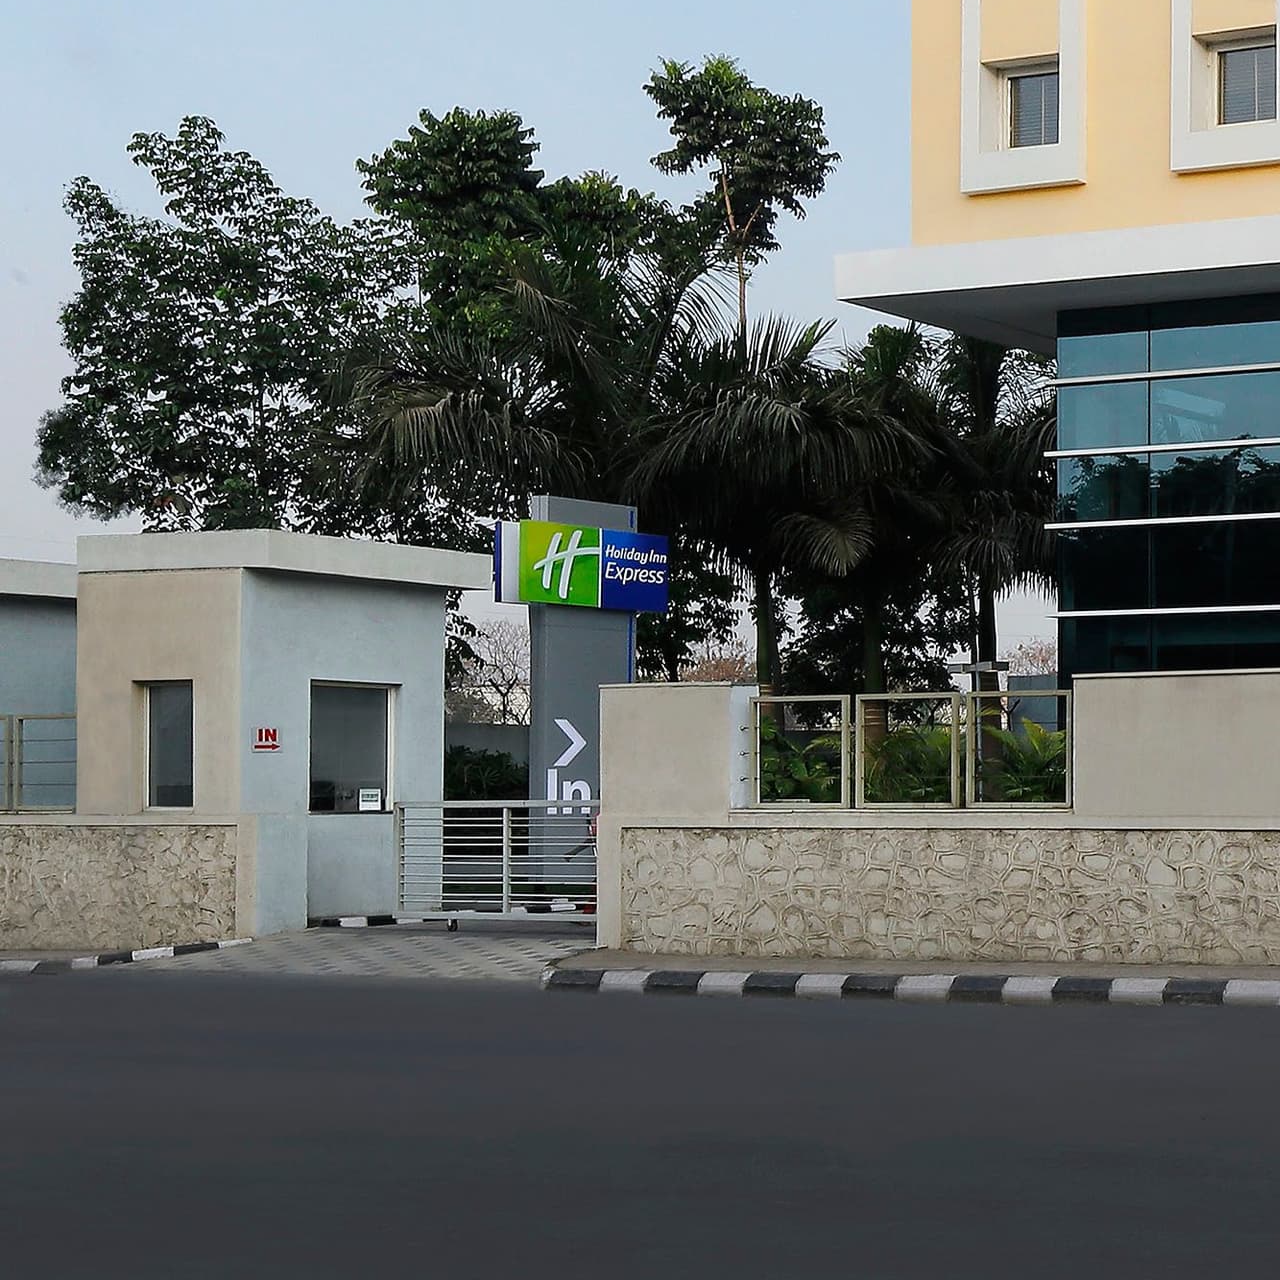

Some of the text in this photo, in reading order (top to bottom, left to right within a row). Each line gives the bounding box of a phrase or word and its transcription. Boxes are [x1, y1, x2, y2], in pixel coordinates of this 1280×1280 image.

[605, 544, 667, 565] Holiday Inn
[605, 562, 665, 585] Express
[258, 728, 277, 742] IN
[547, 769, 591, 815] In
